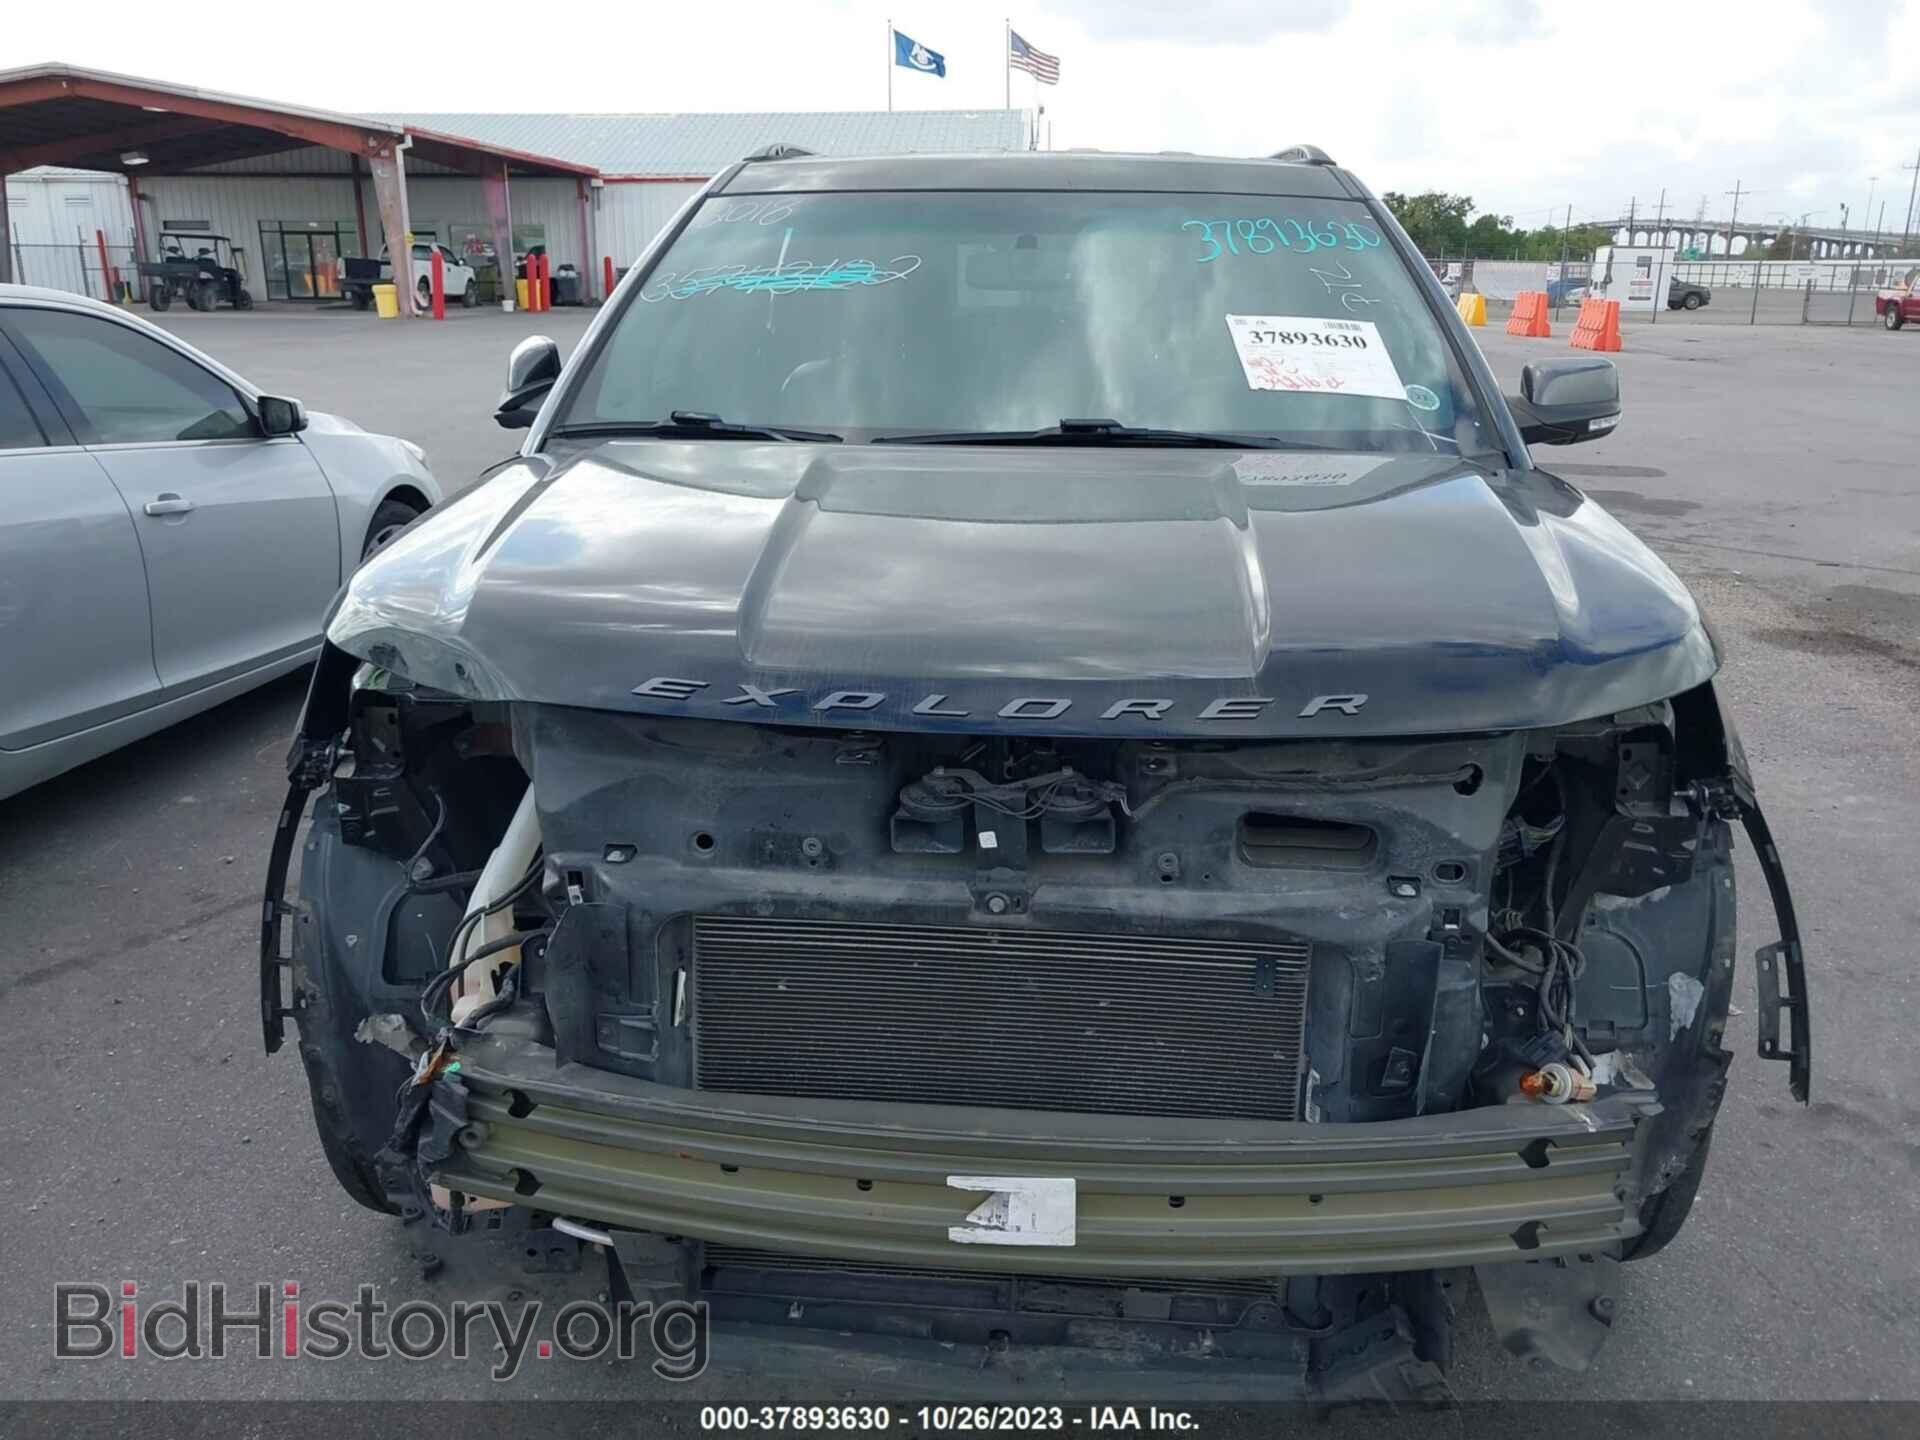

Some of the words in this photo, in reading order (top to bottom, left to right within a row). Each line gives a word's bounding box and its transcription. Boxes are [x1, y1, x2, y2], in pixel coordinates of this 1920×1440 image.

[1181, 218, 1381, 263] 37893630
[1248, 329, 1369, 350] 37893630
[629, 676, 1370, 721] EXPLORER
